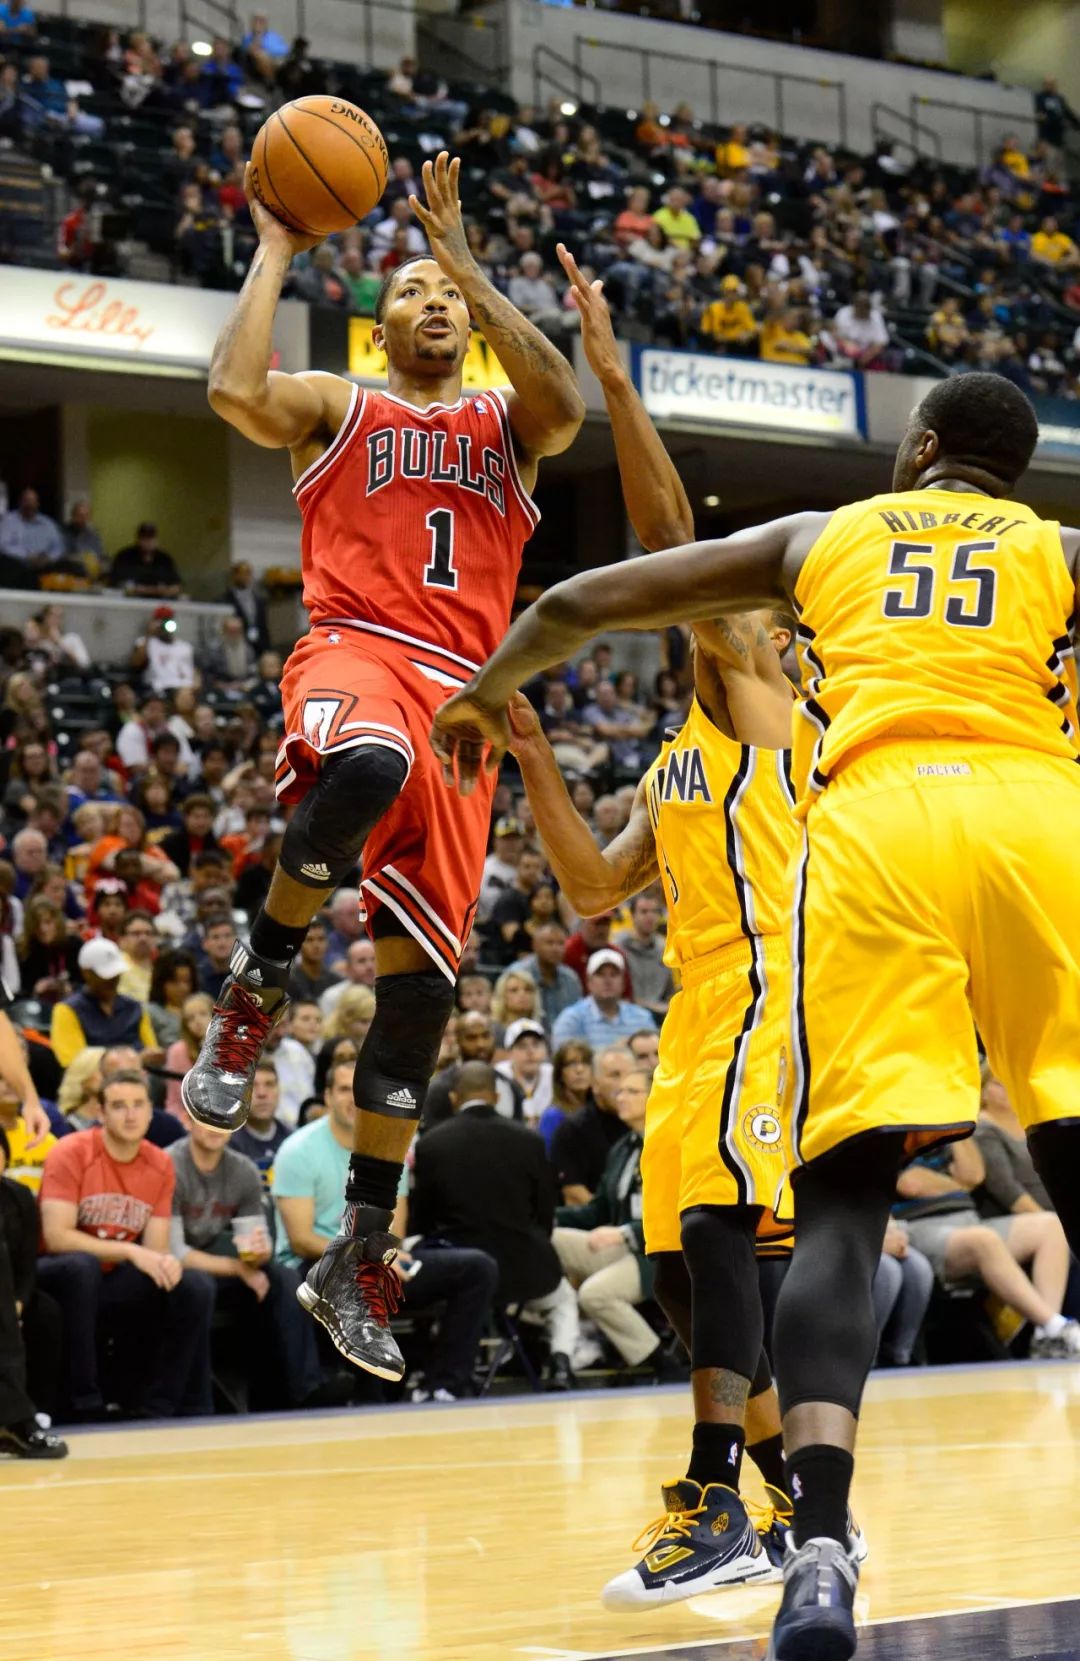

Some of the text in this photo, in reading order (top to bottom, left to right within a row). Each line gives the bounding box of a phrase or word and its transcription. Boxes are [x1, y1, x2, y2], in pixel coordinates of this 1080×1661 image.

[45, 280, 156, 352] Lilly
[648, 356, 849, 413] ticketmaster
[366, 428, 506, 518] BULLS
[423, 508, 458, 591] 1
[879, 510, 1027, 536] HIBBERT
[884, 540, 1000, 629] 55
[387, 1094, 417, 1104] adidas
